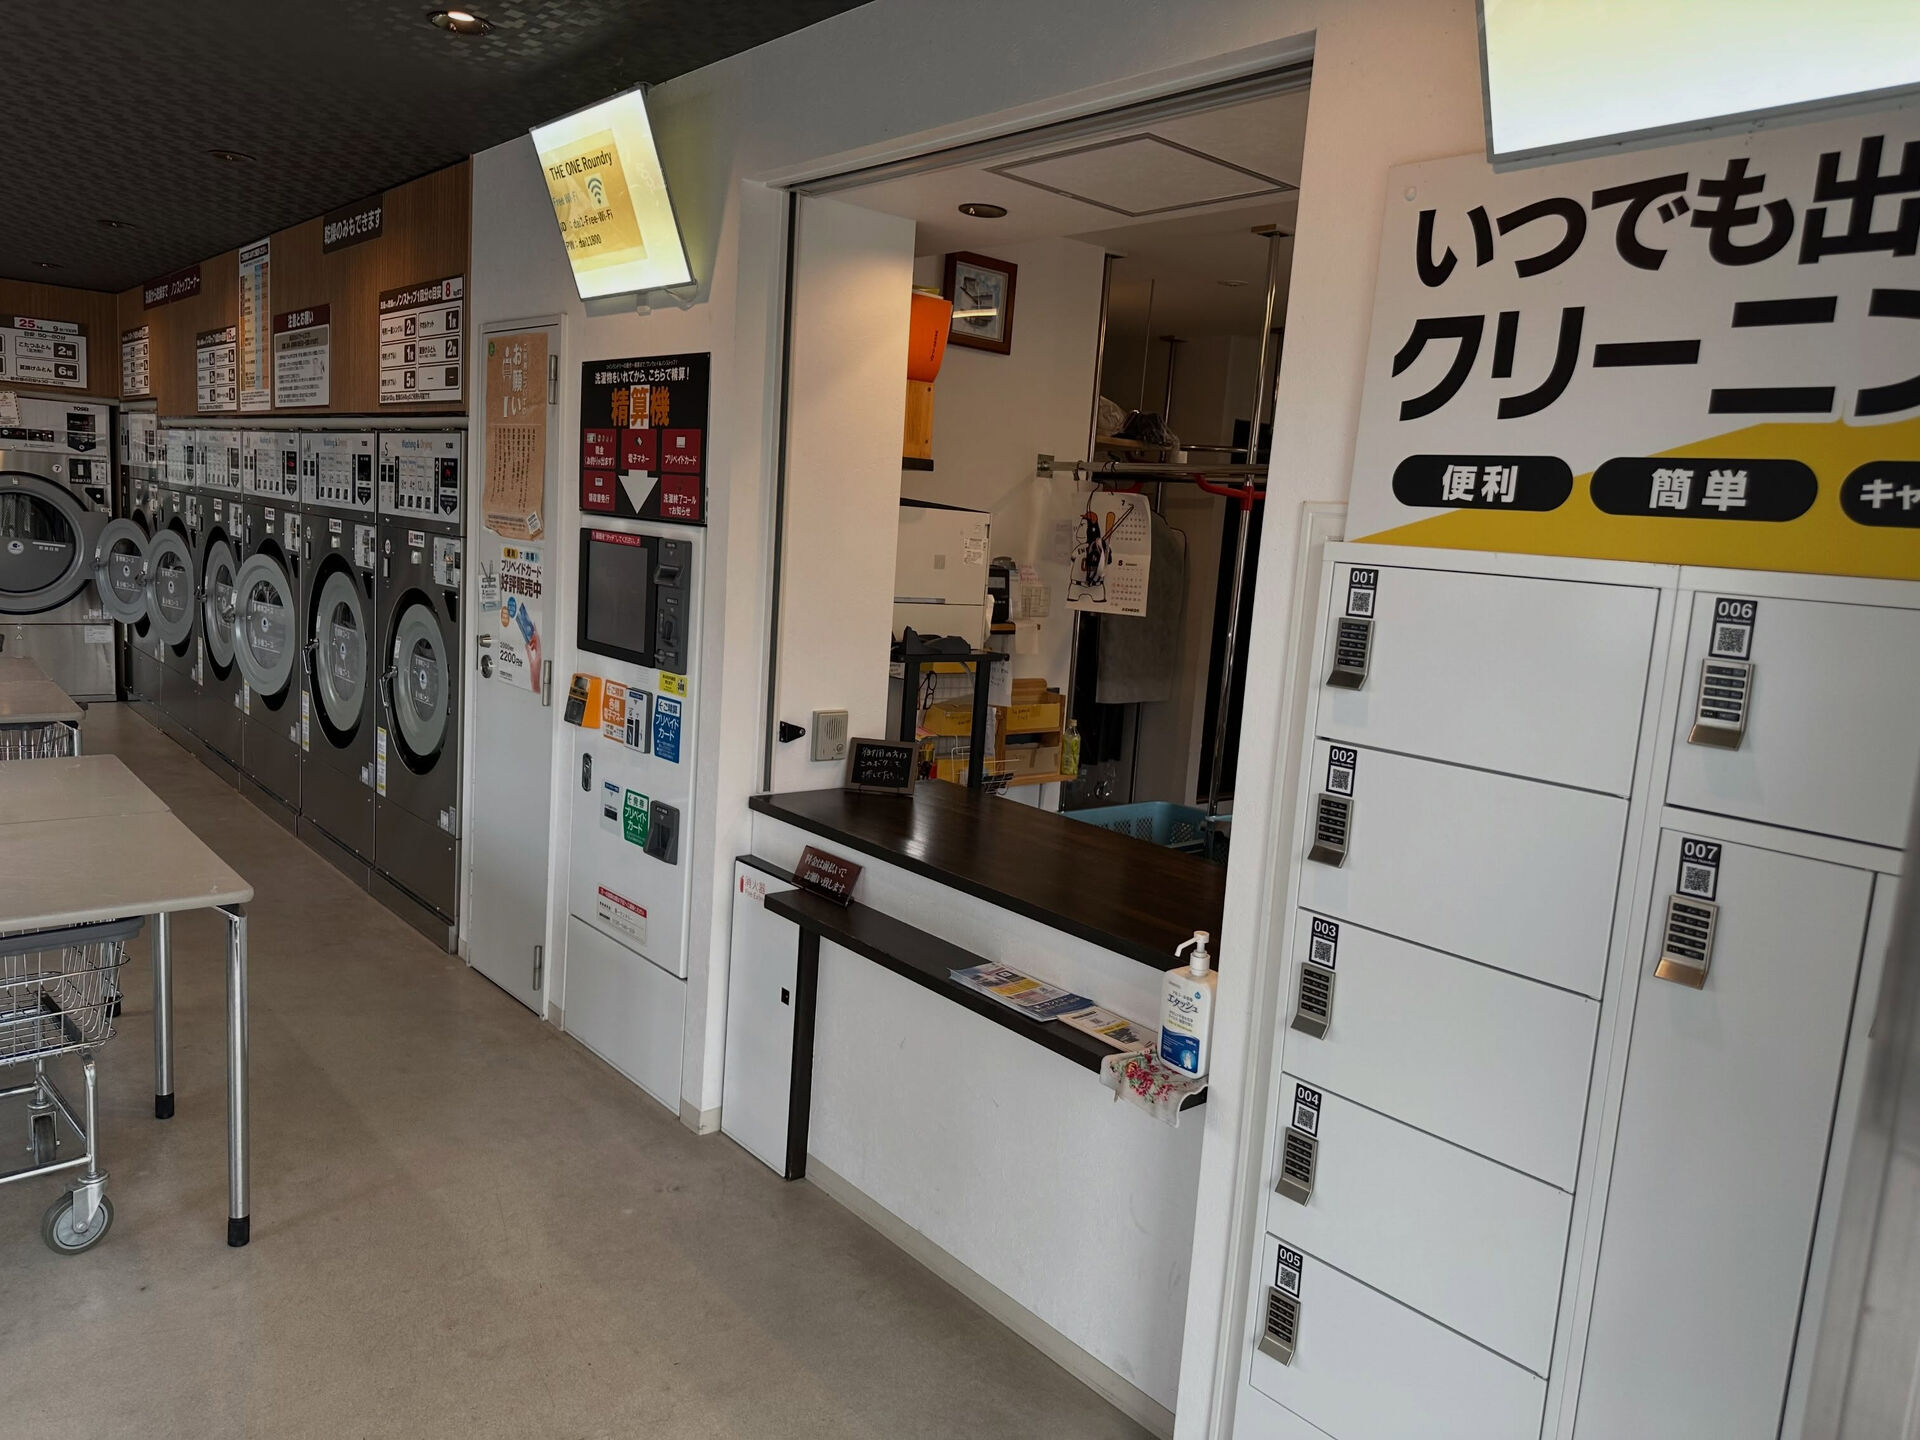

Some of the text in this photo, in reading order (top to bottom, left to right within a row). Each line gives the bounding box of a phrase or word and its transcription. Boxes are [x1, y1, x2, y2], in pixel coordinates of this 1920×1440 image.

[549, 150, 613, 181] THE ONE Roundry
[445, 282, 451, 298] 8
[18, 341, 52, 350] こたつふとん
[513, 343, 523, 416] お願い
[611, 384, 670, 428] 精算機
[384, 441, 388, 456] S
[627, 453, 650, 464] 電子マネー
[664, 454, 697, 466] プリペイドカード
[1441, 464, 1519, 504] 便利
[1648, 467, 1753, 513] 簡単
[501, 559, 543, 577] プリペイドカード
[1352, 570, 1375, 584] 001
[501, 575, 542, 599] 好評販売中
[1718, 601, 1753, 618] 006
[655, 714, 679, 730] プリペイド
[657, 727, 675, 741] カード
[1331, 748, 1355, 764] 002
[625, 806, 647, 824] プリペイド
[627, 820, 643, 834] カード
[1684, 841, 1718, 860] 007
[803, 870, 846, 897] お願い致します
[1314, 920, 1336, 936] 003
[1297, 1087, 1319, 1105] 004
[1279, 1248, 1301, 1266] 005
